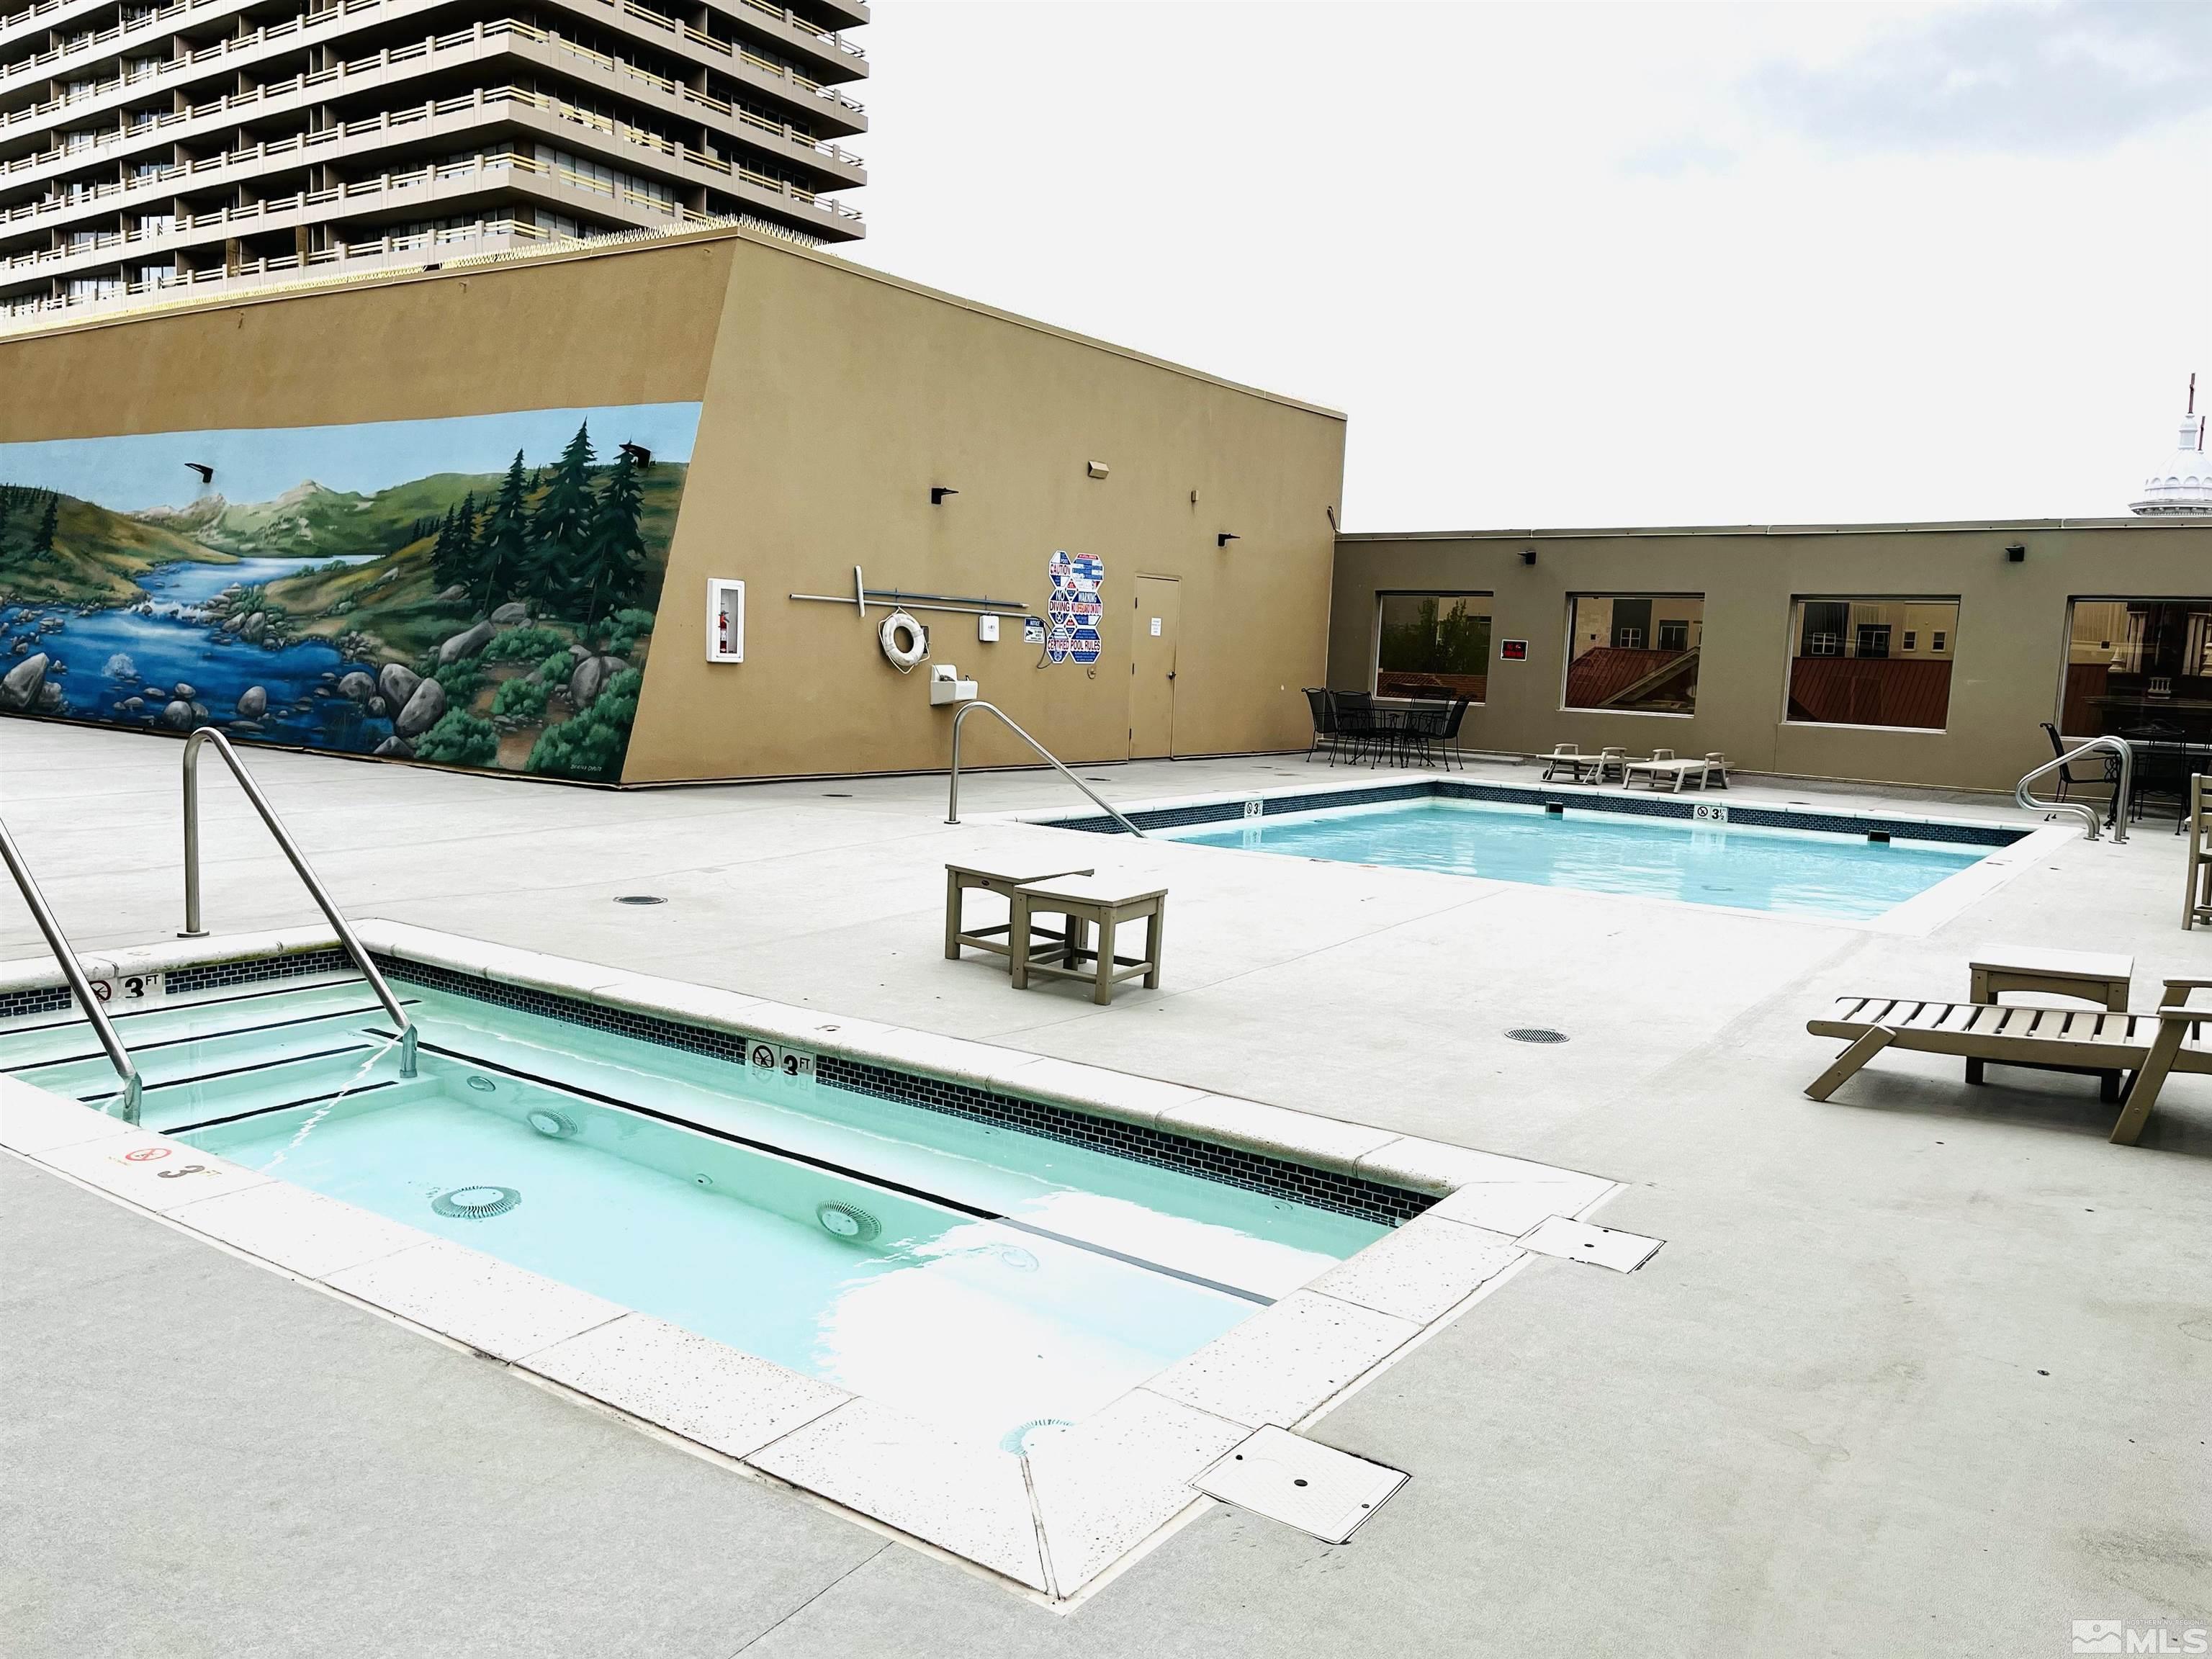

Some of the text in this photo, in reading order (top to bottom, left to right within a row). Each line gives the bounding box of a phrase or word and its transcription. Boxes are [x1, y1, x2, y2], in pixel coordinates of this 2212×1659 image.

[1051, 564, 1071, 575] CAUTION
[1056, 590, 1064, 601] NO
[1079, 592, 1097, 603] WARNING
[1050, 601, 1069, 611] DIVING
[1048, 640, 1069, 649] CERTIFIED
[1071, 640, 1100, 650] POOL RULES
[1254, 803, 1259, 814] 3
[1712, 809, 1719, 819] 3
[125, 974, 158, 998] 3 FT
[783, 1055, 810, 1076] 3 FT
[157, 1165, 205, 1178] 3
